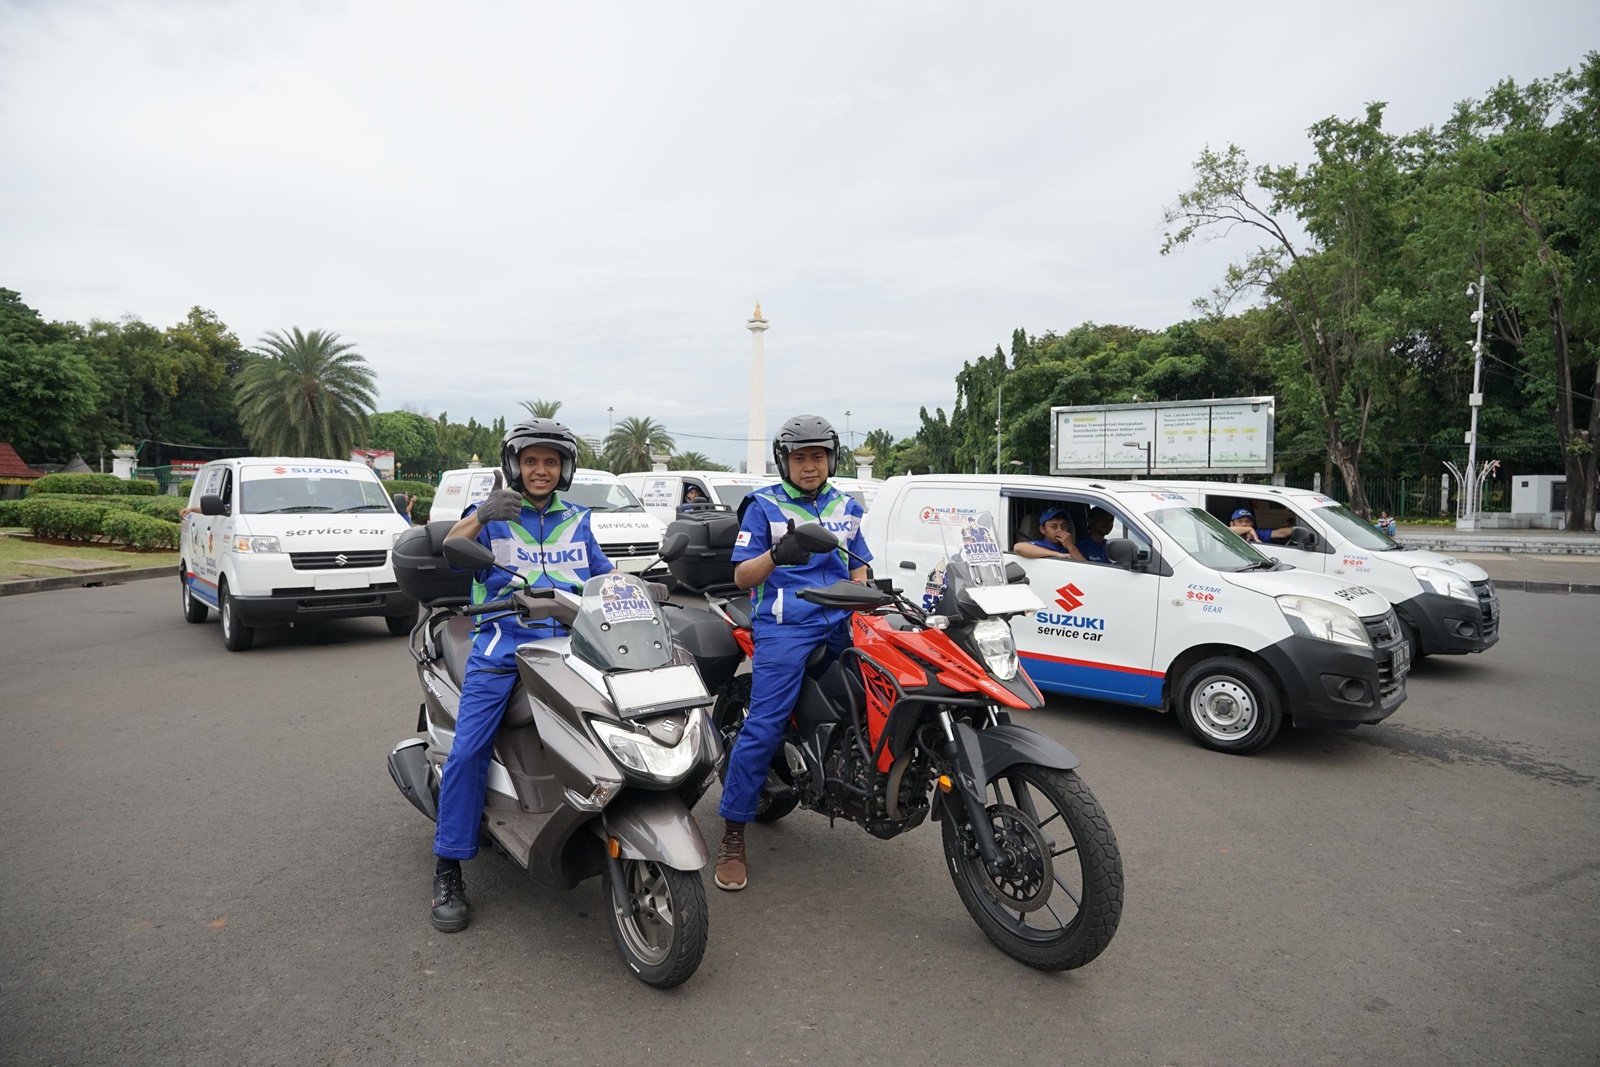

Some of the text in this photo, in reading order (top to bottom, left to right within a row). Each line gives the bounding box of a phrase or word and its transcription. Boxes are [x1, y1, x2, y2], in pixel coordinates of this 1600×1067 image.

[286, 527, 353, 536] service
[964, 544, 998, 554] SUZUKI
[517, 547, 583, 564] SUZUKI
[1188, 584, 1222, 593] ECSTAR
[603, 600, 650, 612] SUZUKI
[1203, 605, 1222, 613] GEAR
[1036, 612, 1104, 630] SUZUKI
[1038, 626, 1103, 641] service car
